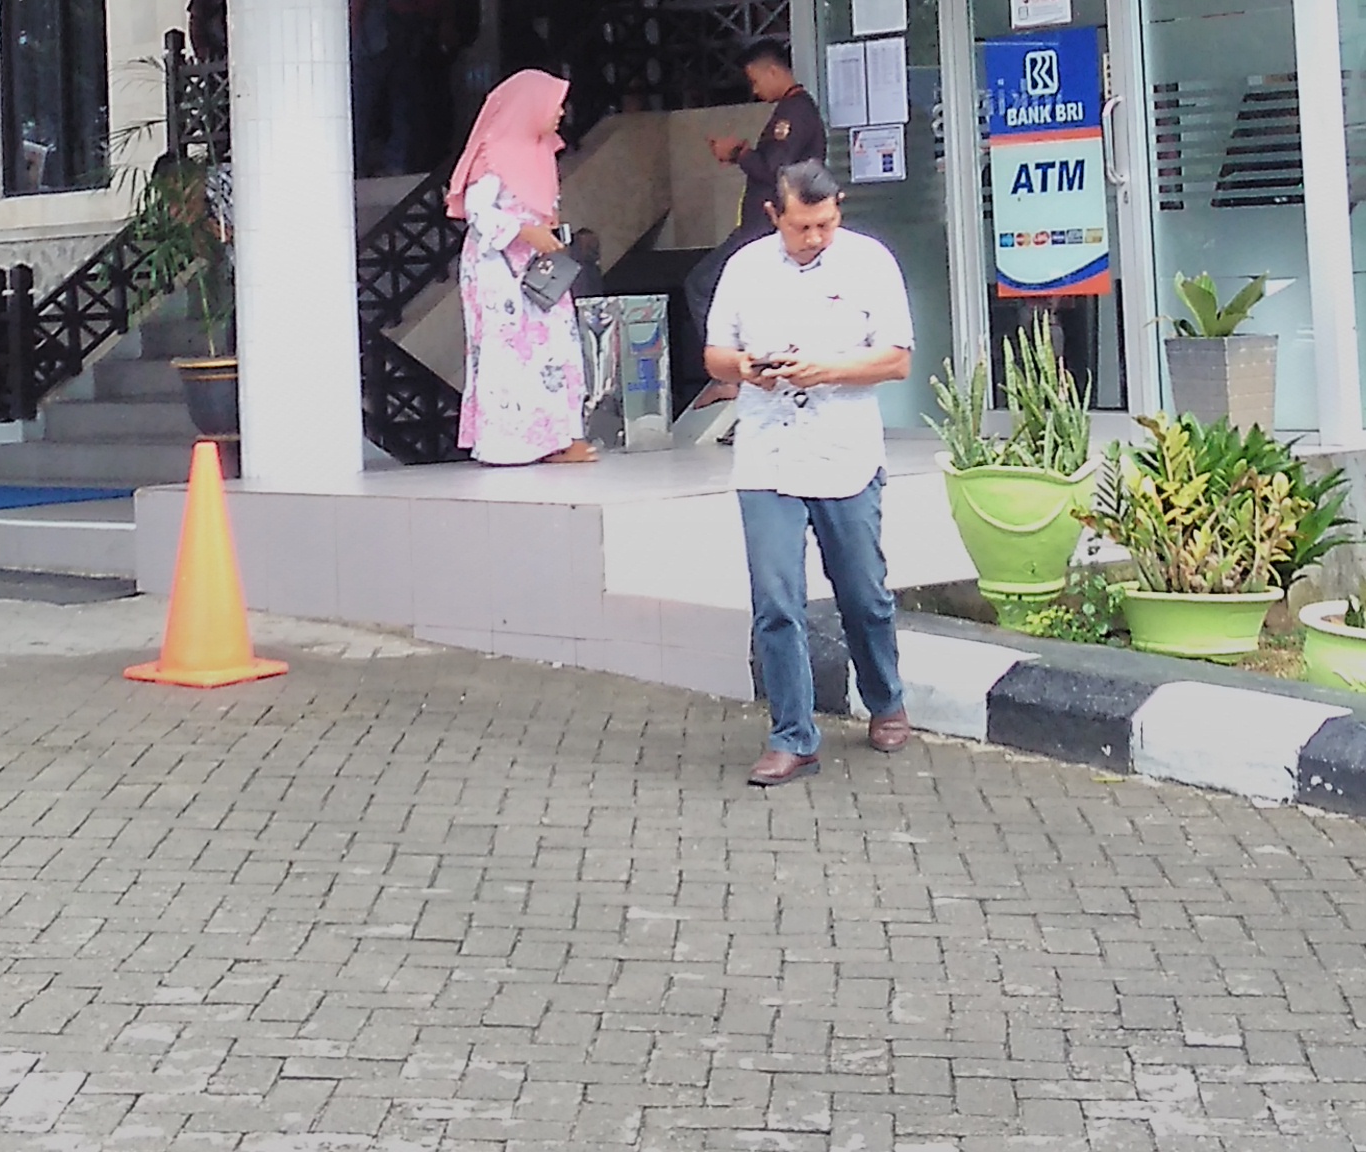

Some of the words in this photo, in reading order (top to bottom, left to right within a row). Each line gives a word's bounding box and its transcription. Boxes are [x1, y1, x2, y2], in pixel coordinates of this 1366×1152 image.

[1006, 104, 1053, 127] BANK
[1055, 101, 1084, 122] BRI
[1010, 158, 1085, 195] ATM
